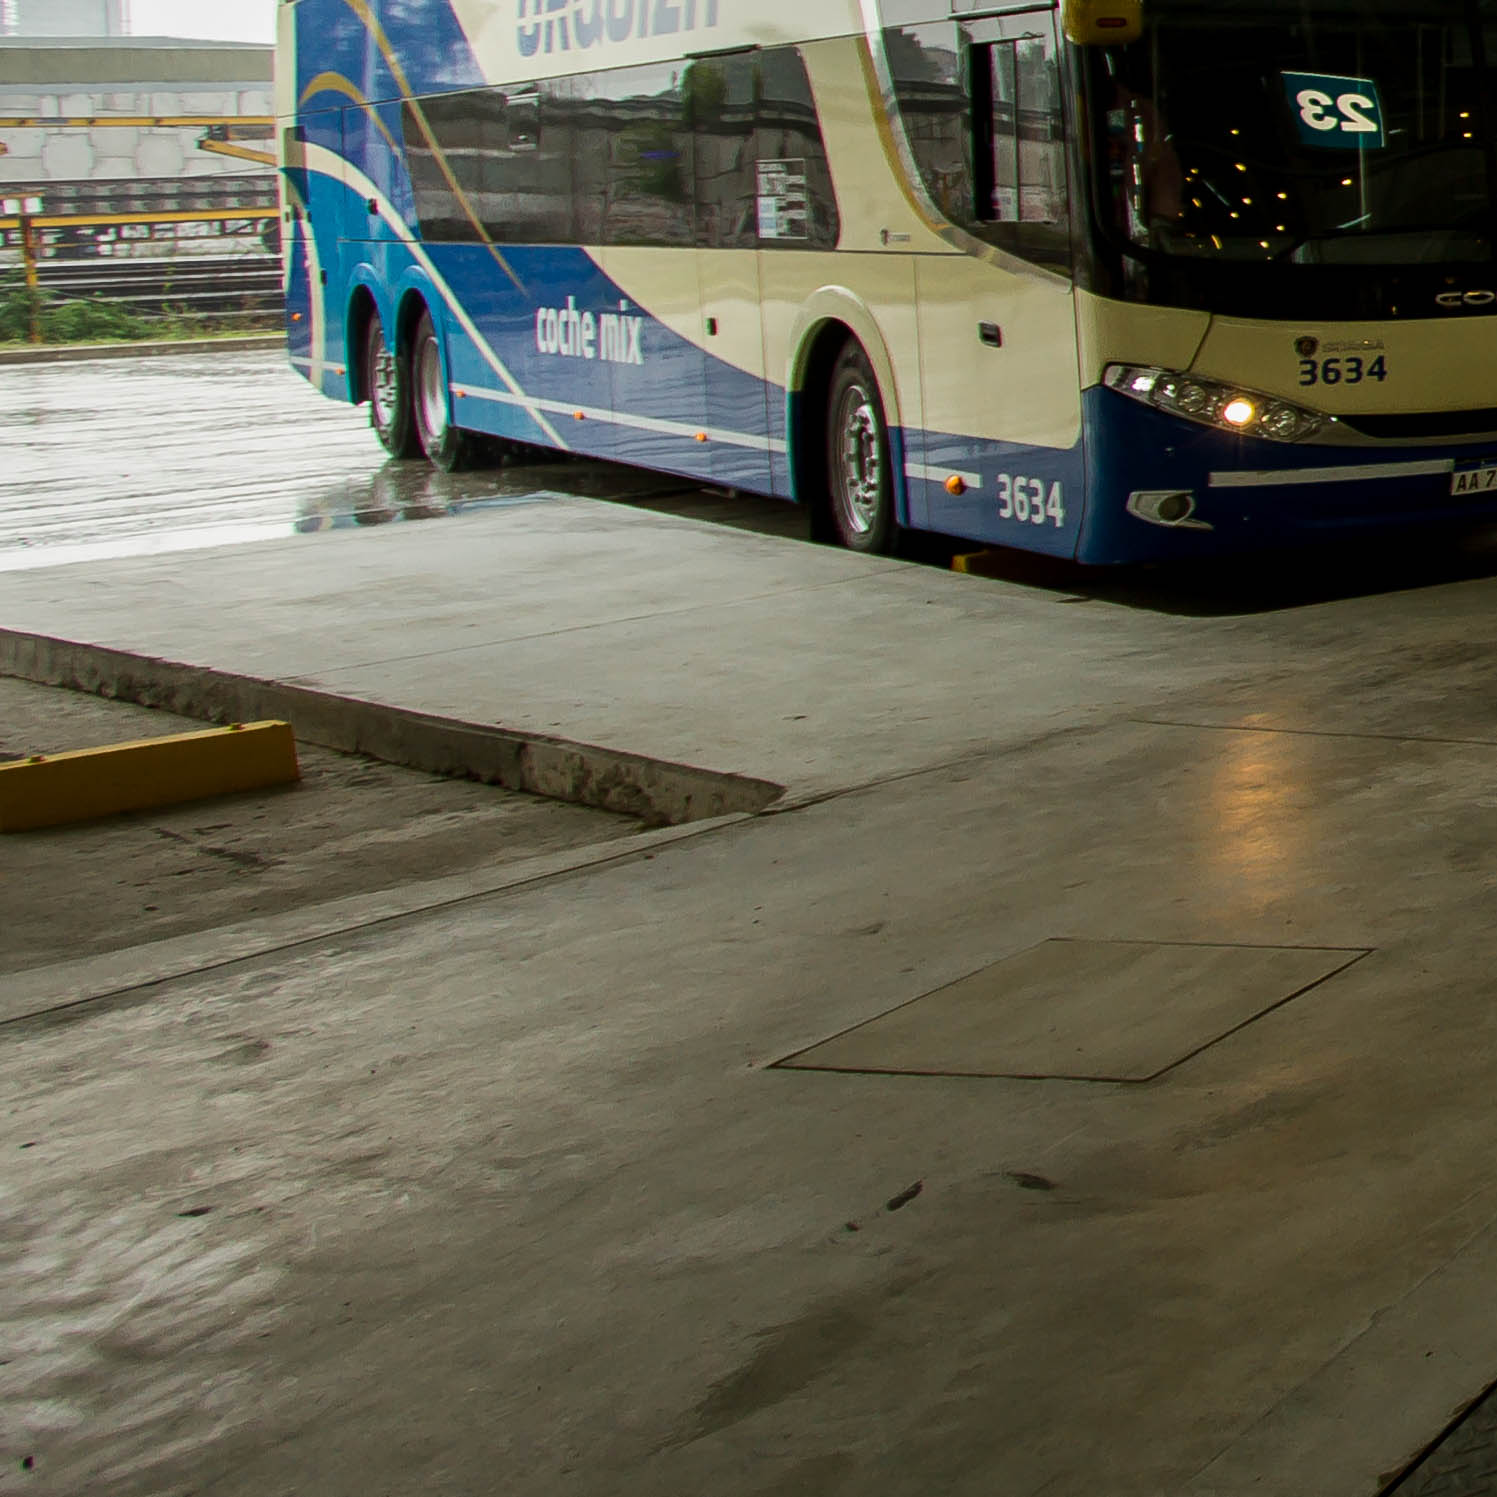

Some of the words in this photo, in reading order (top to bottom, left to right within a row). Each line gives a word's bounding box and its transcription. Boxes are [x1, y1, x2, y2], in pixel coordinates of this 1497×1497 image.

[537, 295, 595, 358] coche
[600, 301, 643, 365] mix
[1299, 355, 1388, 386] 3634
[998, 472, 1063, 528] 3634
[1455, 473, 1479, 493] AA
